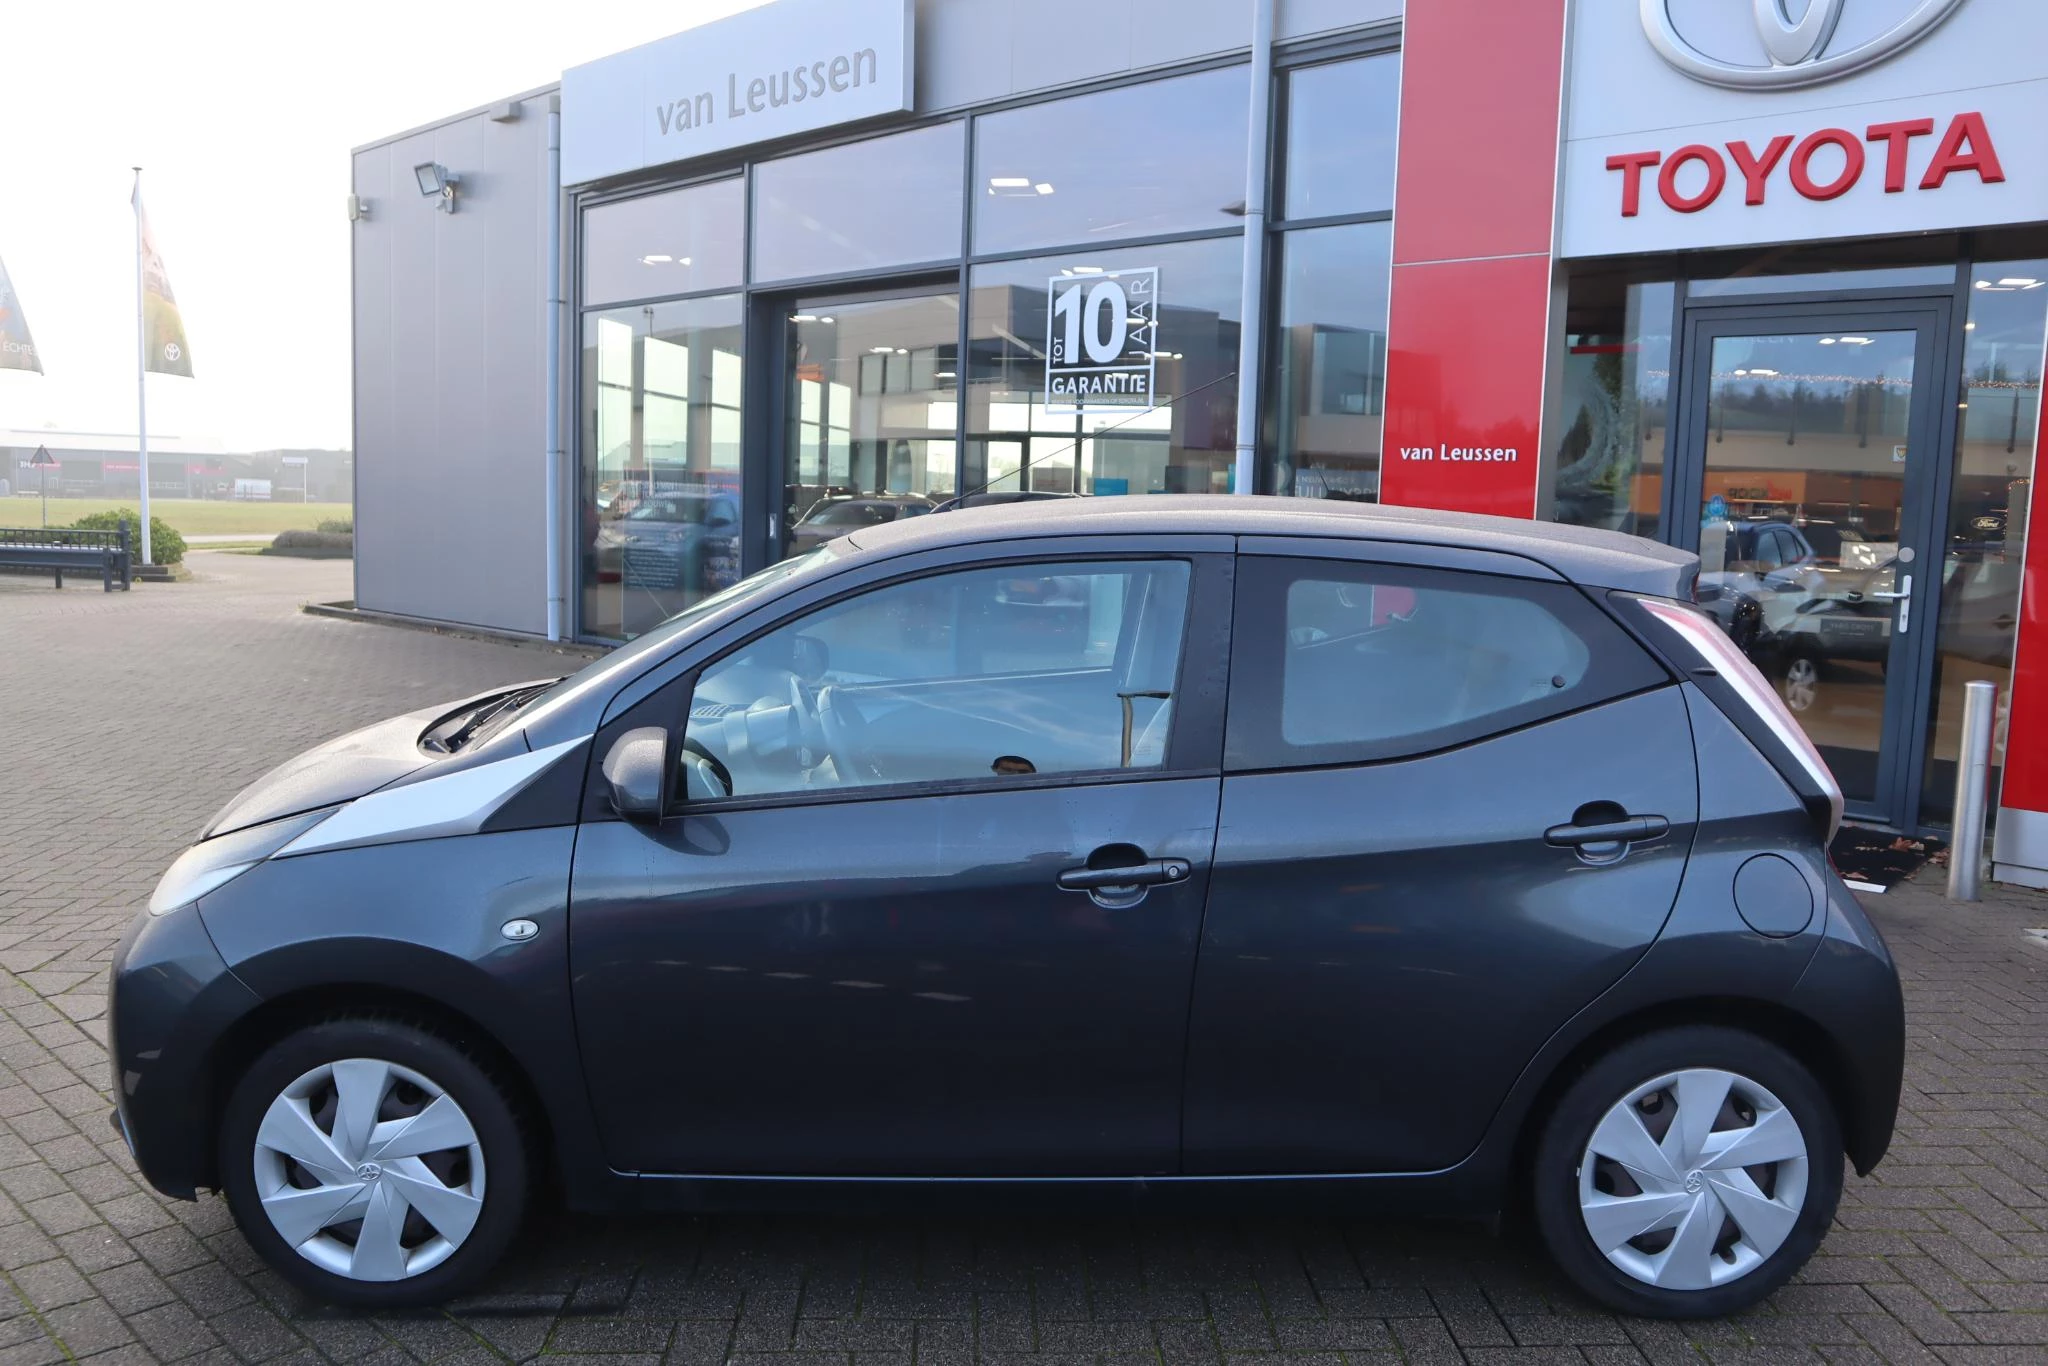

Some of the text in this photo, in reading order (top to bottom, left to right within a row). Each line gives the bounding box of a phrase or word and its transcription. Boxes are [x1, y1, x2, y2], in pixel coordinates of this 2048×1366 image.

[656, 48, 877, 136] van Leussen
[1605, 112, 2006, 218] TOYOTA
[1053, 337, 1063, 365] TOT
[1054, 281, 1128, 364] 10
[1129, 278, 1150, 360] JAAR
[1051, 374, 1146, 394] GARANTIE
[1400, 444, 1517, 462] van Leussen
